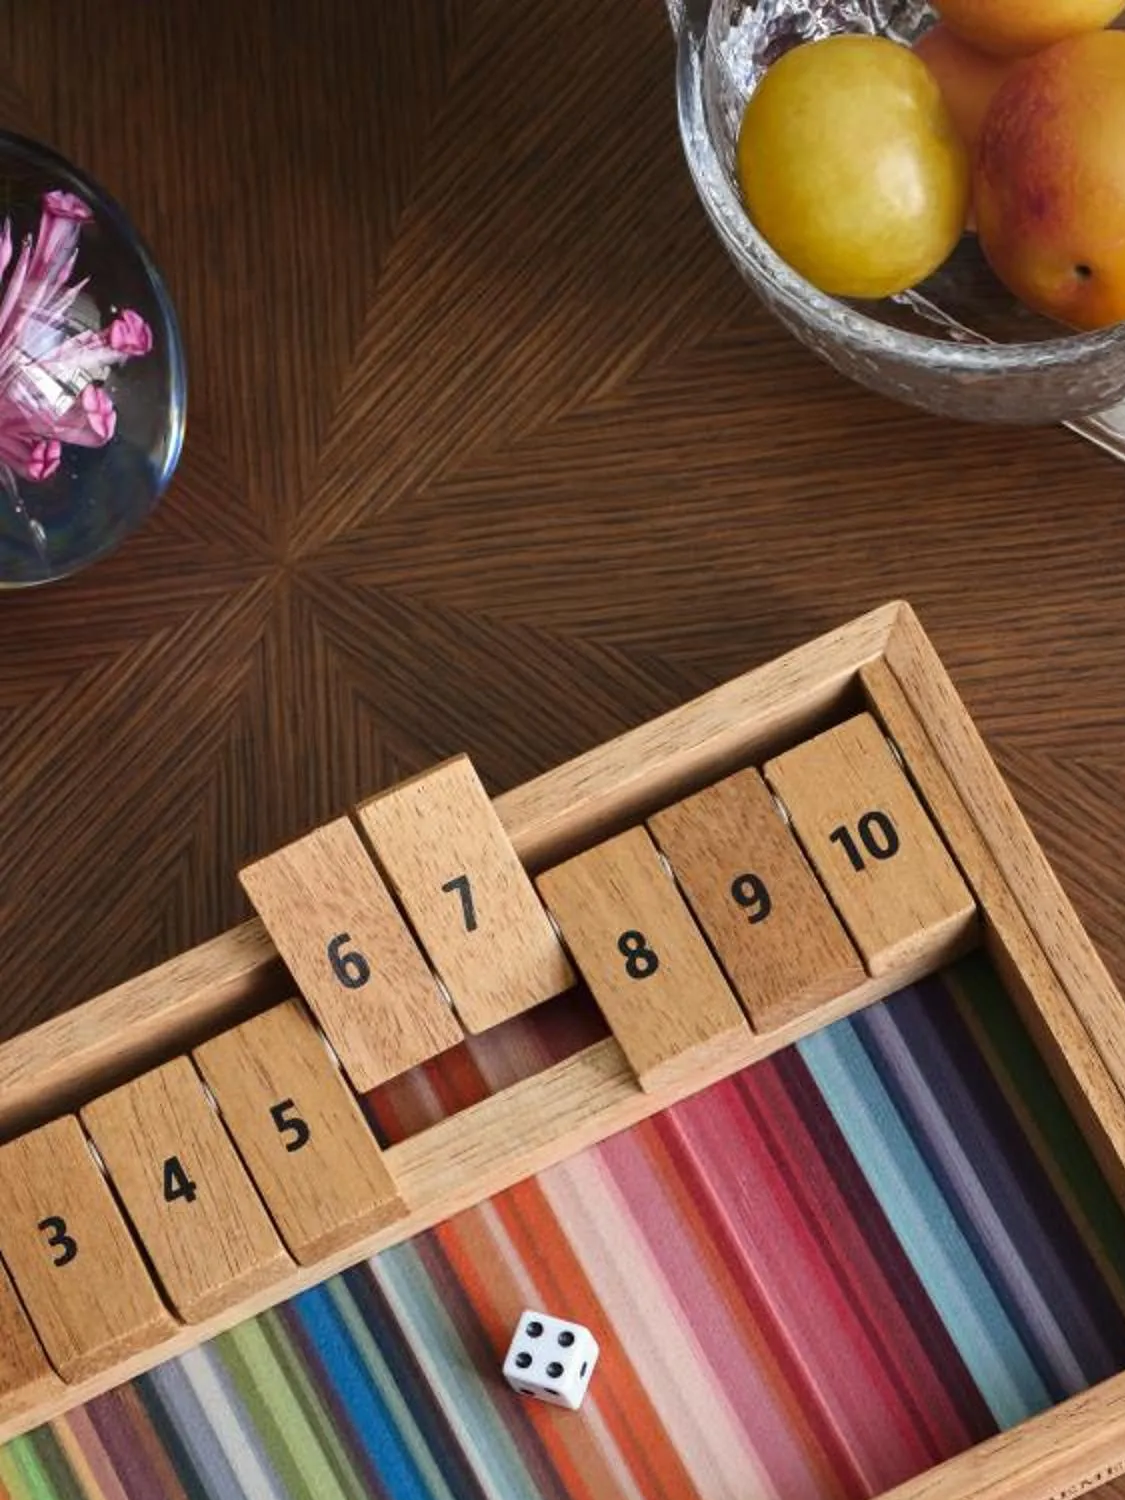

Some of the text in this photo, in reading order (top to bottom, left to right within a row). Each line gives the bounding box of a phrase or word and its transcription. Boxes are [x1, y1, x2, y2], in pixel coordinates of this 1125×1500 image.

[829, 811, 900, 872] 10
[441, 875, 478, 932] 7
[730, 873, 772, 925] 9
[327, 932, 371, 990] 6
[617, 930, 659, 980] 8
[269, 1098, 310, 1153] 5
[162, 1156, 197, 1204] 4
[37, 1215, 78, 1268] 3
